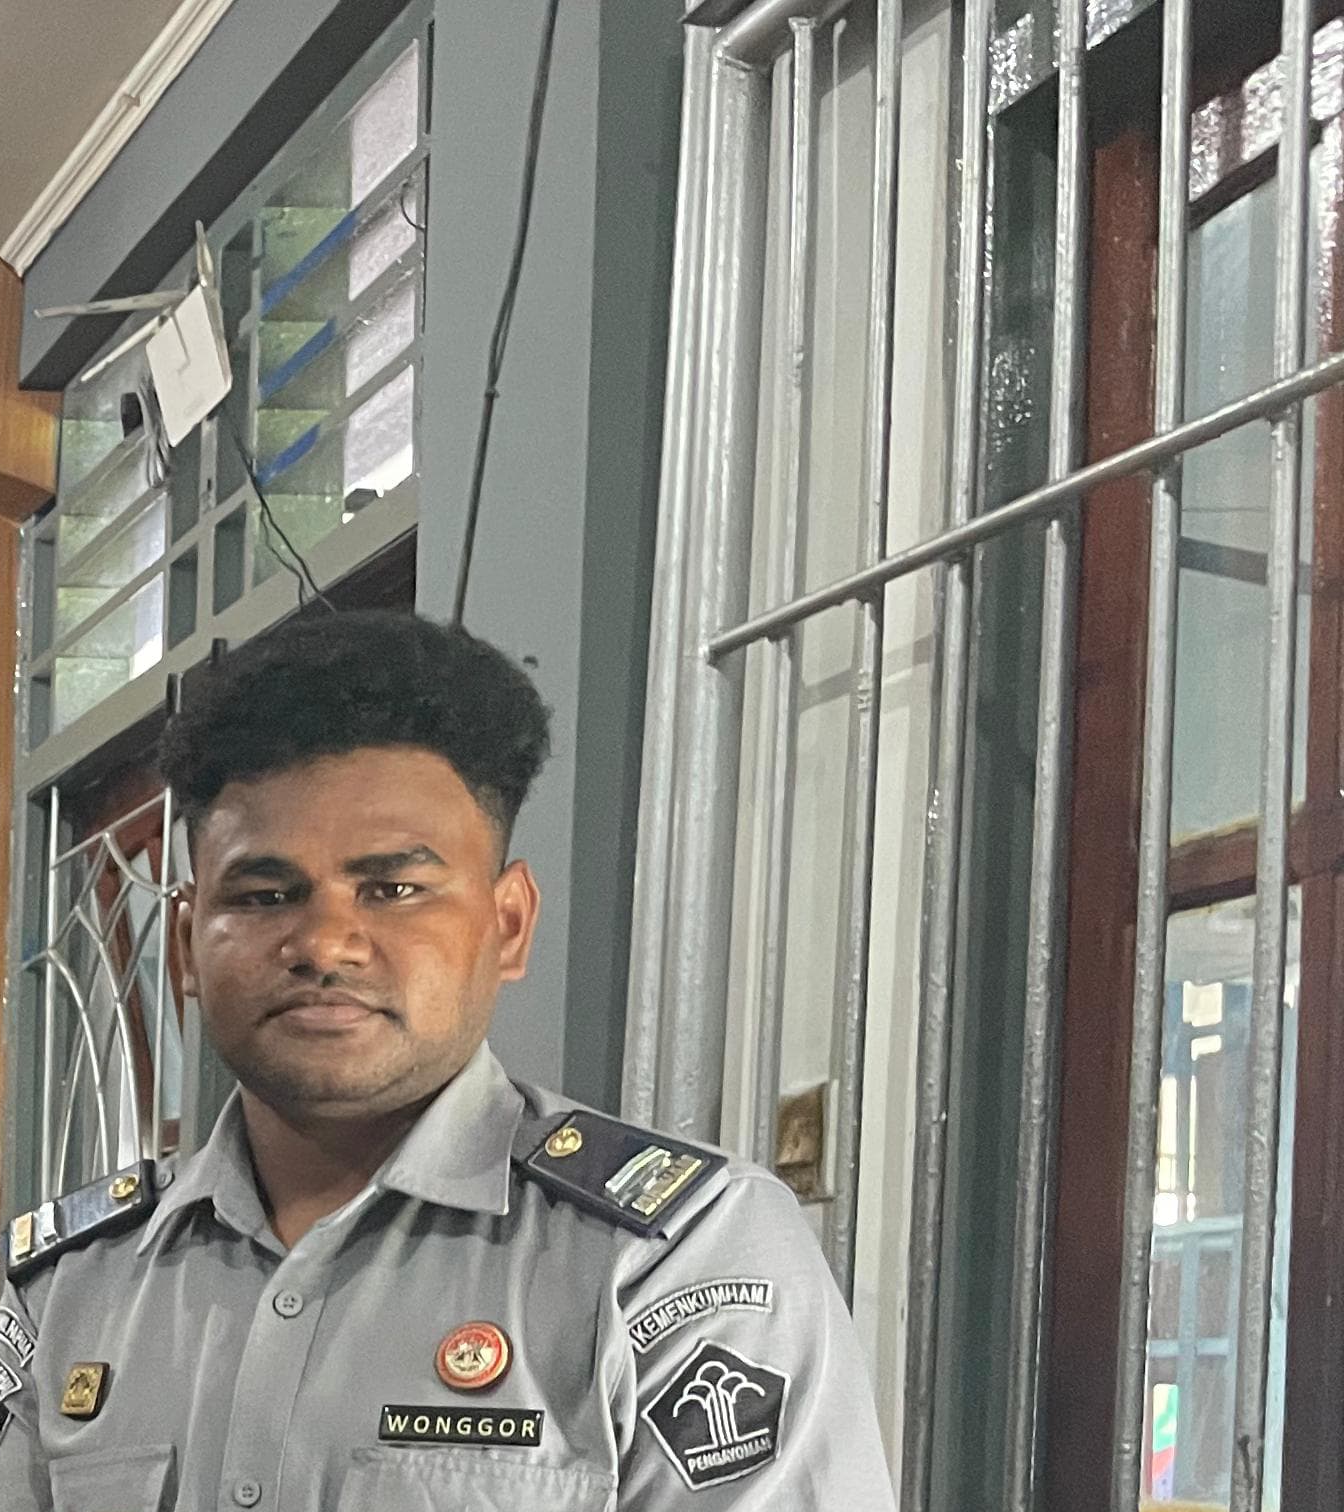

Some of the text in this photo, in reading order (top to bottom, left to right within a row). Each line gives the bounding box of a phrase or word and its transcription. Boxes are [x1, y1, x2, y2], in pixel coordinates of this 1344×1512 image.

[630, 1283, 765, 1346] KEMENKUMHAM
[386, 1414, 536, 1439] WONGGOR
[686, 1437, 773, 1475] PENGAYOMAN
